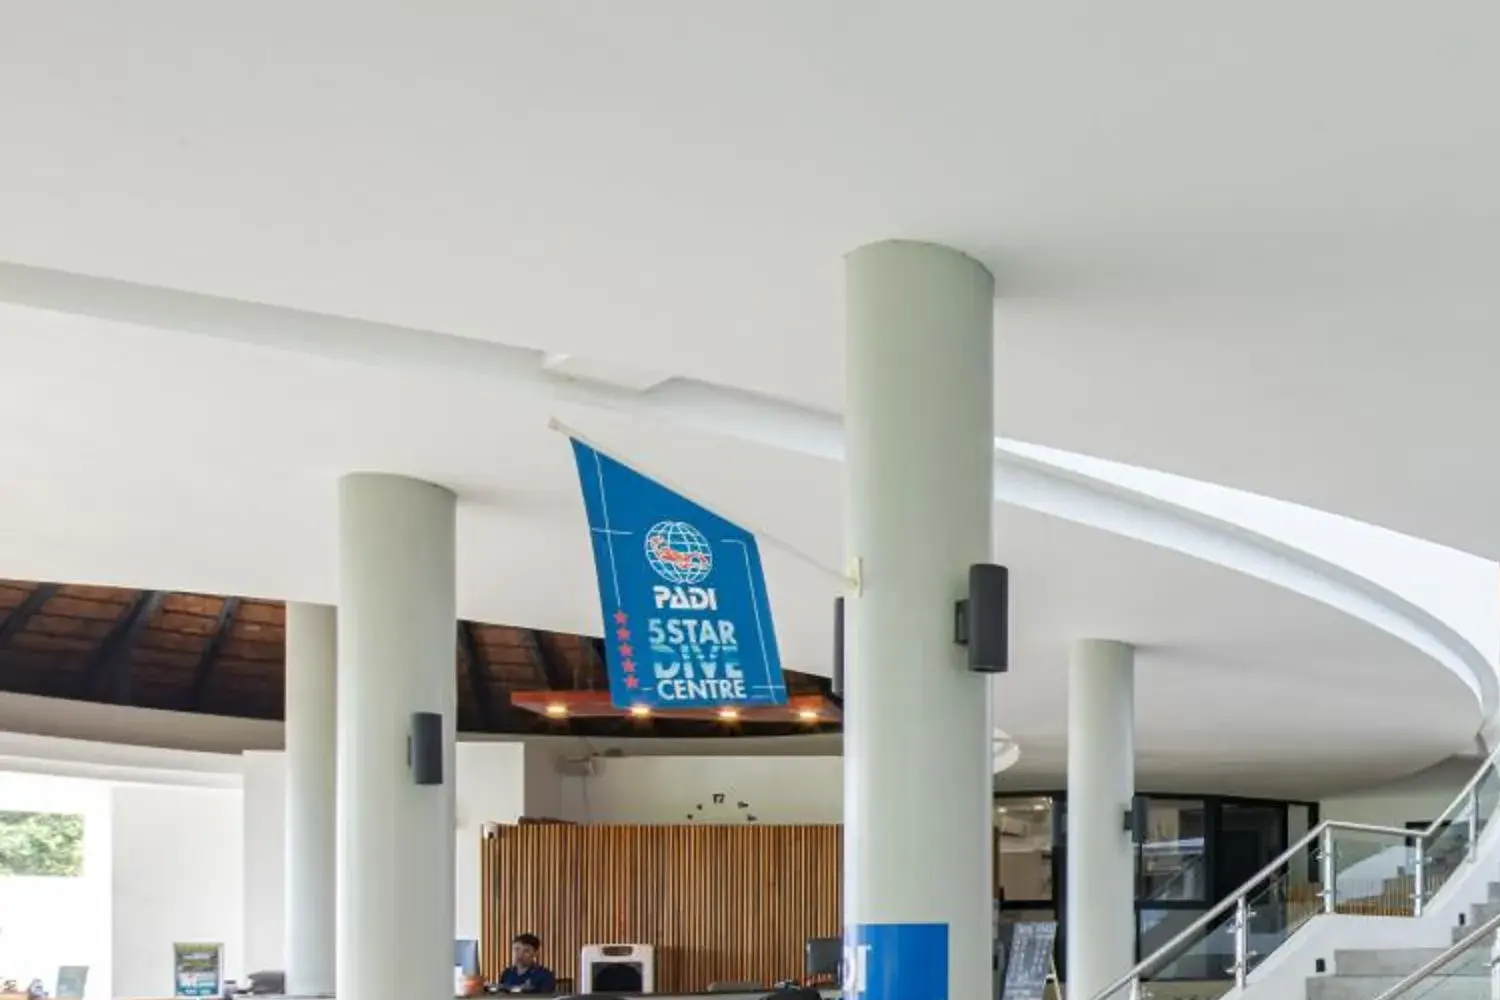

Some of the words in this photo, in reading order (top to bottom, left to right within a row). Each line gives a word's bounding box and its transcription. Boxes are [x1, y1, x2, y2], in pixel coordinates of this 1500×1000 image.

[653, 585, 717, 610] PADI
[648, 619, 666, 644] 5
[667, 619, 737, 645] STAR
[657, 680, 747, 700] CENTRE
